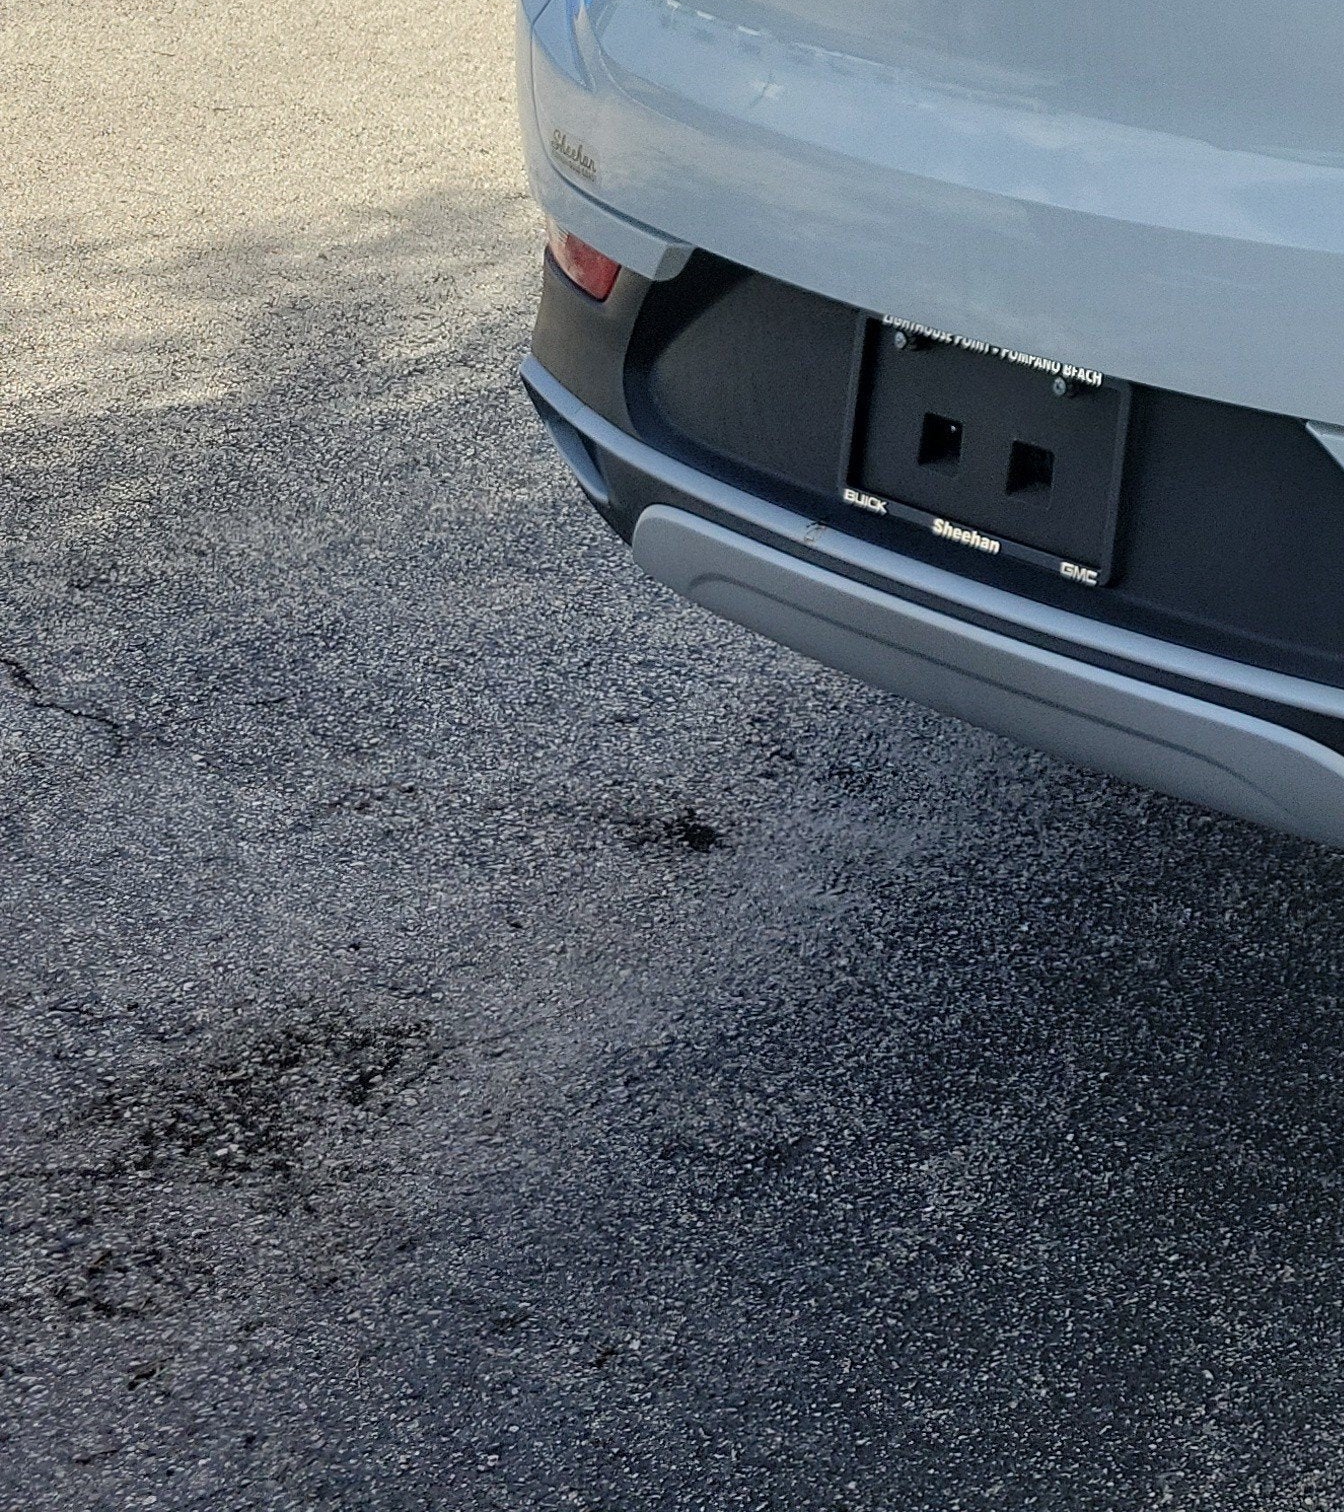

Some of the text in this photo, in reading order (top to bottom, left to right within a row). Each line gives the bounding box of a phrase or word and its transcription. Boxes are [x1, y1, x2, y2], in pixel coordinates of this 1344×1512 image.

[1062, 364, 1103, 387] BEACH
[843, 488, 1099, 587] BUICK Sheehan GMC
